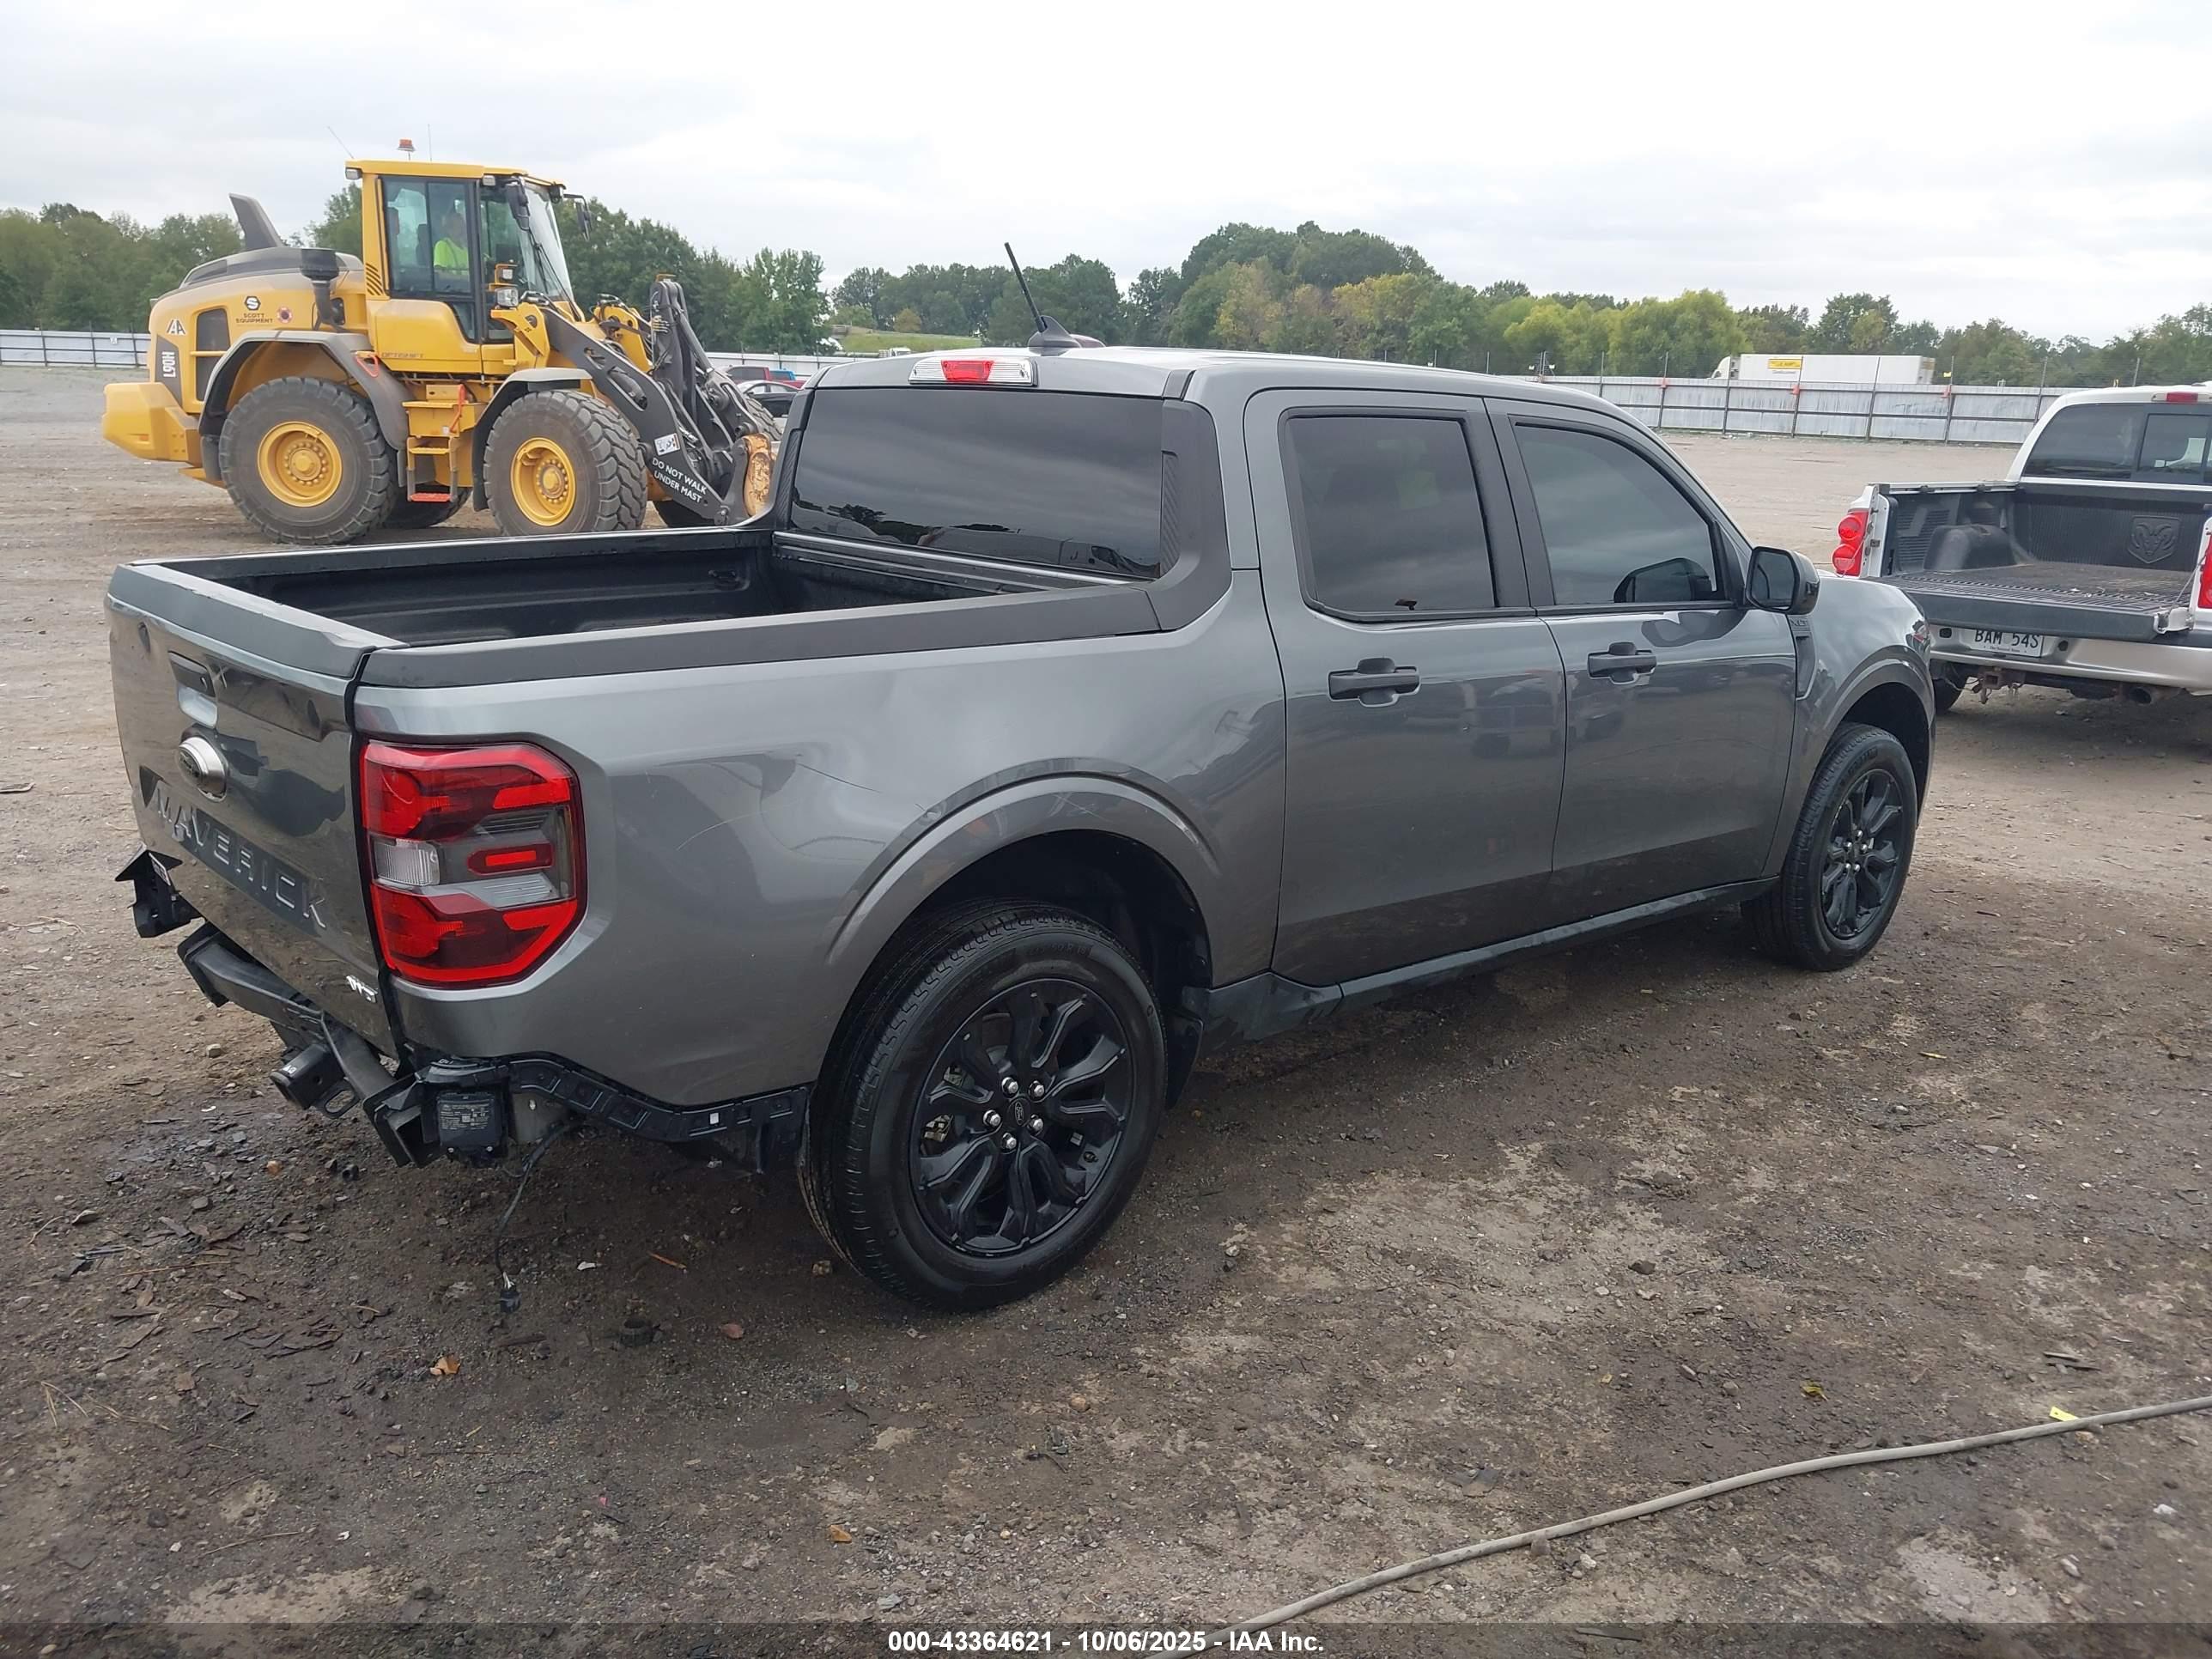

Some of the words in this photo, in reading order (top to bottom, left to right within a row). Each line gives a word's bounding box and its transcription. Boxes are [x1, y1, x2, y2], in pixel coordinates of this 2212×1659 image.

[161, 351, 176, 378] L90H
[653, 457, 665, 469] DO
[665, 465, 684, 480] NOT
[684, 475, 707, 495] WALK
[654, 471, 679, 491] UNDER
[680, 486, 702, 503] MAST
[1974, 629, 2002, 645] BAM
[157, 787, 326, 928] MAVERICK
